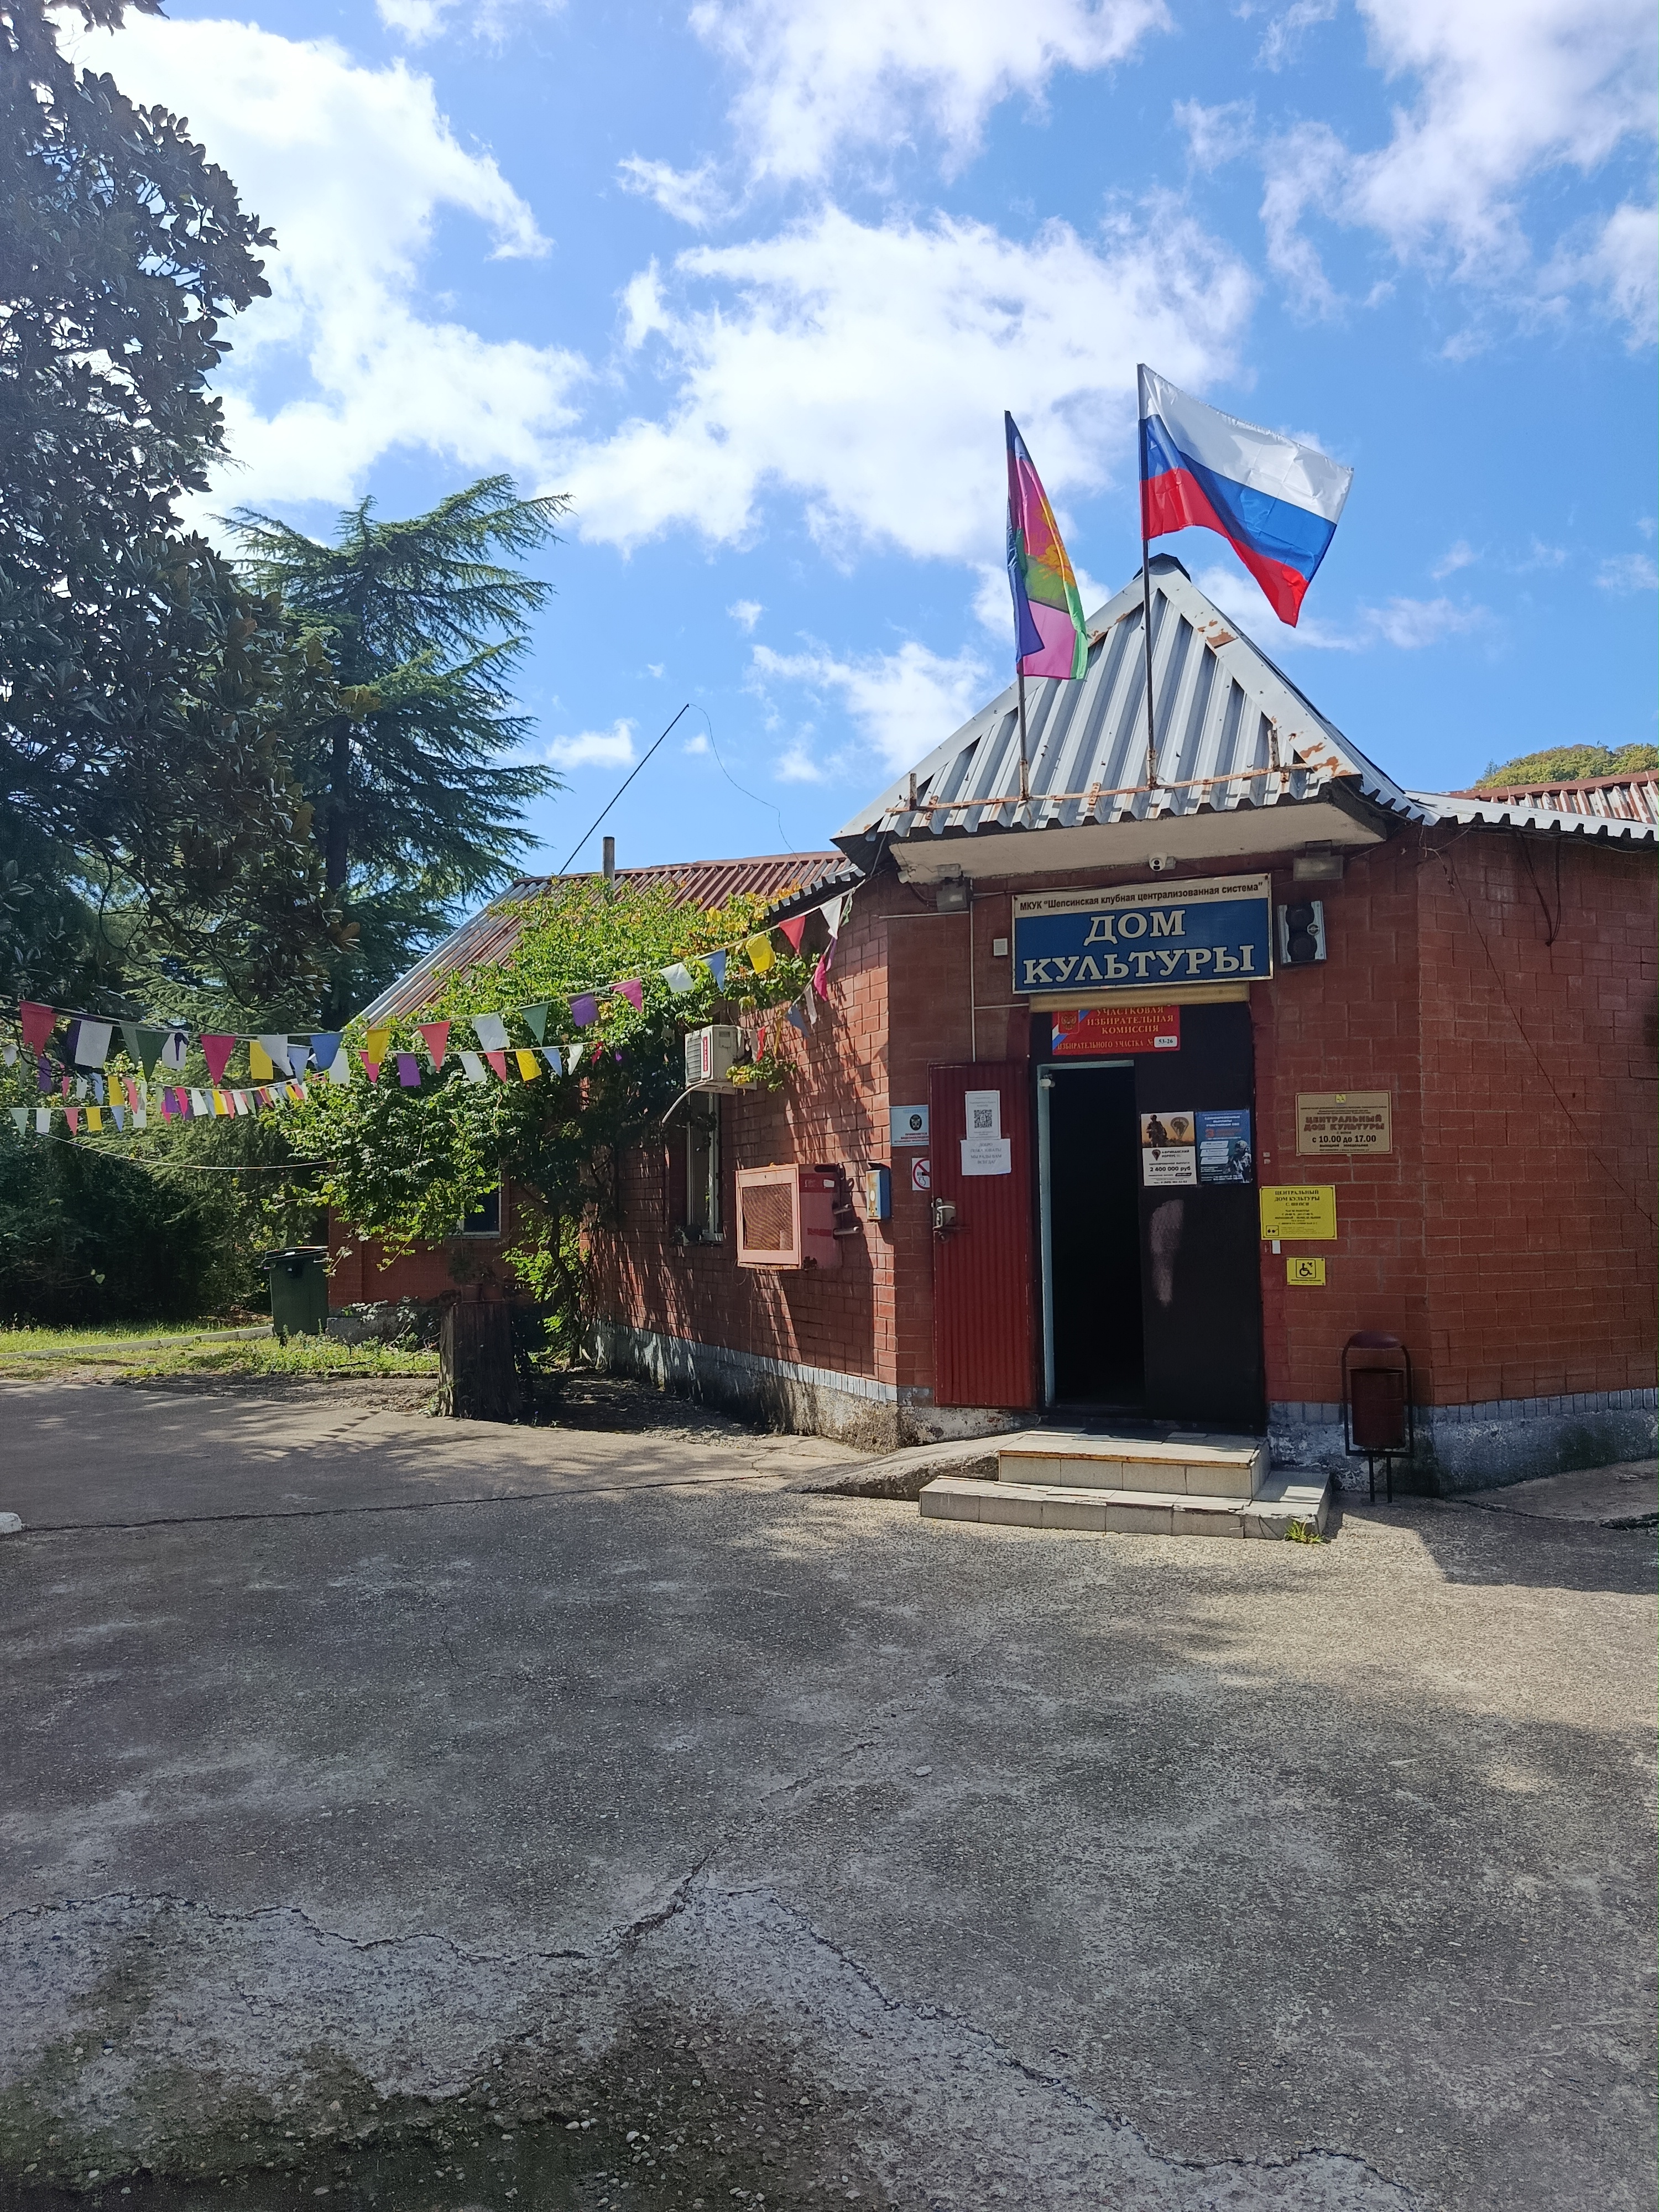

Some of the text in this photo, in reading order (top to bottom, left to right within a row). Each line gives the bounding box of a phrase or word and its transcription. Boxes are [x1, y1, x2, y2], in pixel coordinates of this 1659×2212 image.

[1020, 901, 1042, 911] МКУК
[1100, 893, 1135, 904] клубная
[1138, 886, 1220, 902] централизованная
[1083, 910, 1186, 946] ДОМ
[1023, 945, 1255, 984] КУЛЬТУРЫ
[1097, 1006, 1164, 1016] УЧАСТКОВАЯ
[1087, 1015, 1173, 1026] ИЗБИРАТЕЛЬНАЯ
[1102, 1025, 1159, 1034] КОМИССИЯ
[1057, 1041, 1113, 1050] ИЗБИРАТЕЛЬНОГО
[1115, 1040, 1144, 1048] УЧАСТКА
[1306, 1114, 1382, 1124] ЦЕНТРАЛЬНЫЙ
[1303, 1123, 1385, 1132] ДОМ КУЛЬТУРЫ
